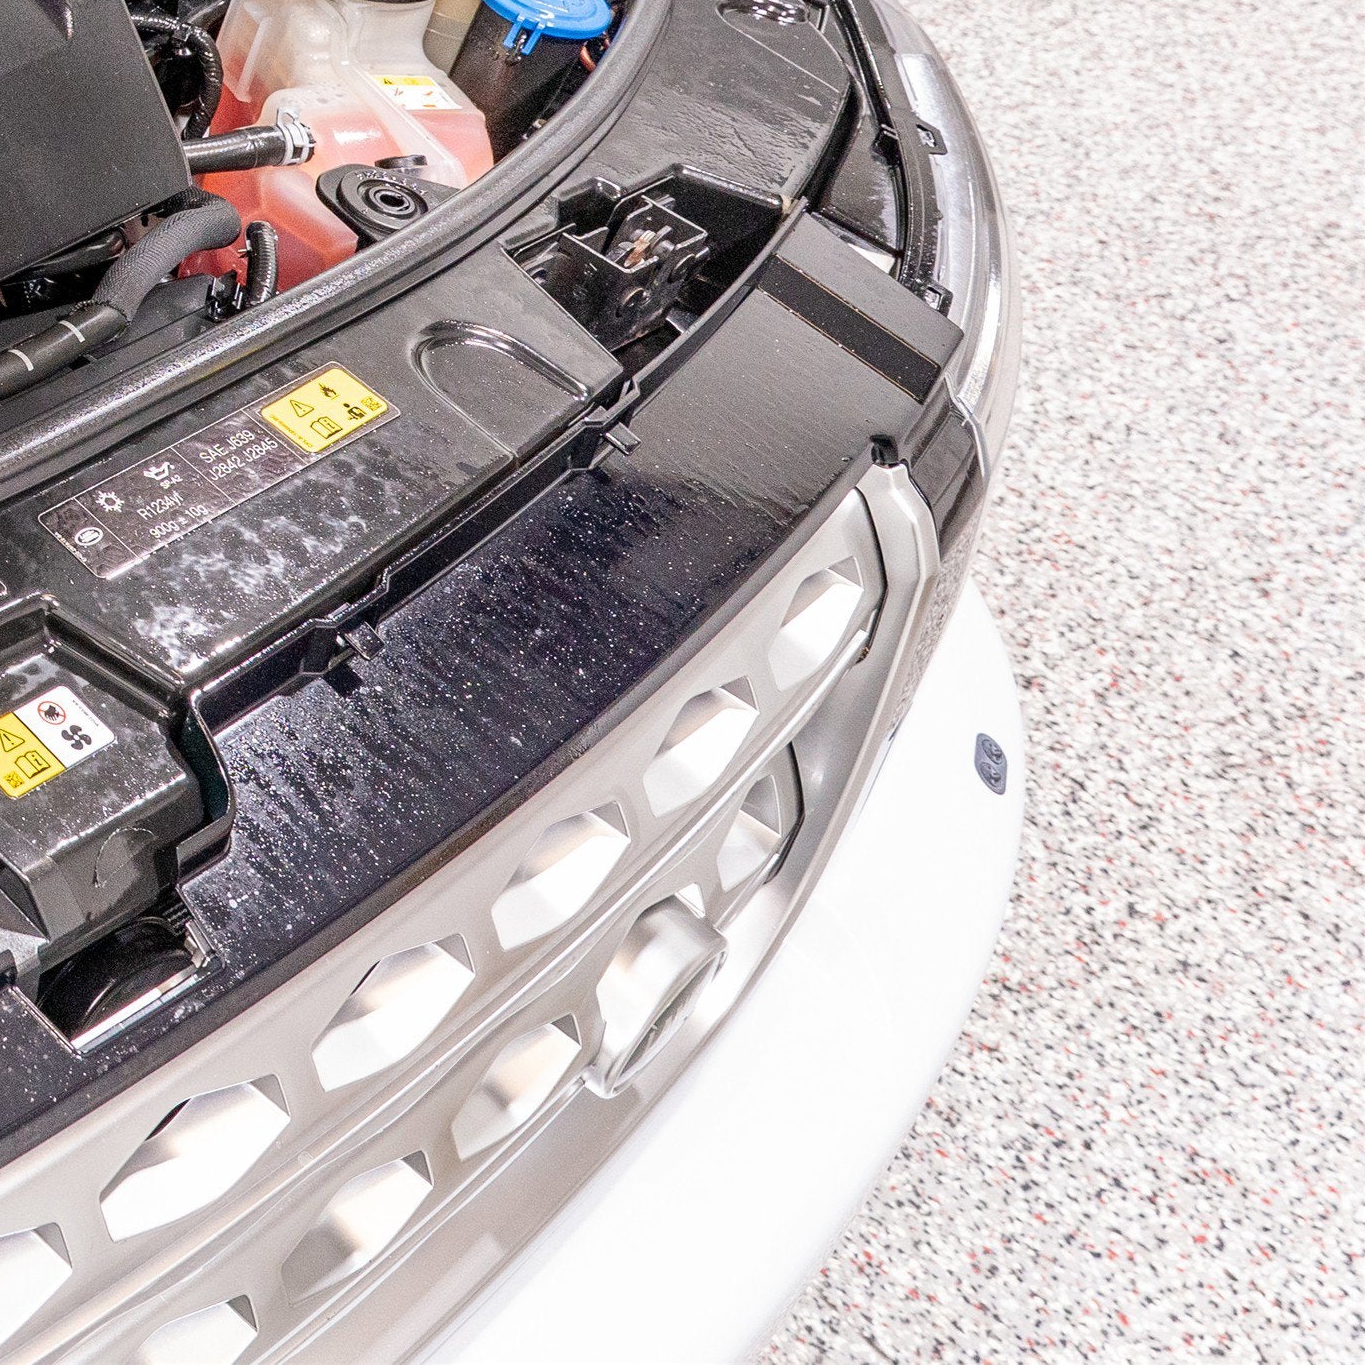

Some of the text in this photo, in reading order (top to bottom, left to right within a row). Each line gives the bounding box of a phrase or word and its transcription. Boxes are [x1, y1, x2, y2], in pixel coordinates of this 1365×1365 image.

[199, 444, 228, 464] SAE
[228, 429, 256, 451] J639
[209, 437, 279, 481] J2842 J2845
[137, 491, 184, 521] R1234yf
[149, 519, 181, 539] 900g
[185, 504, 208, 521] 10g
